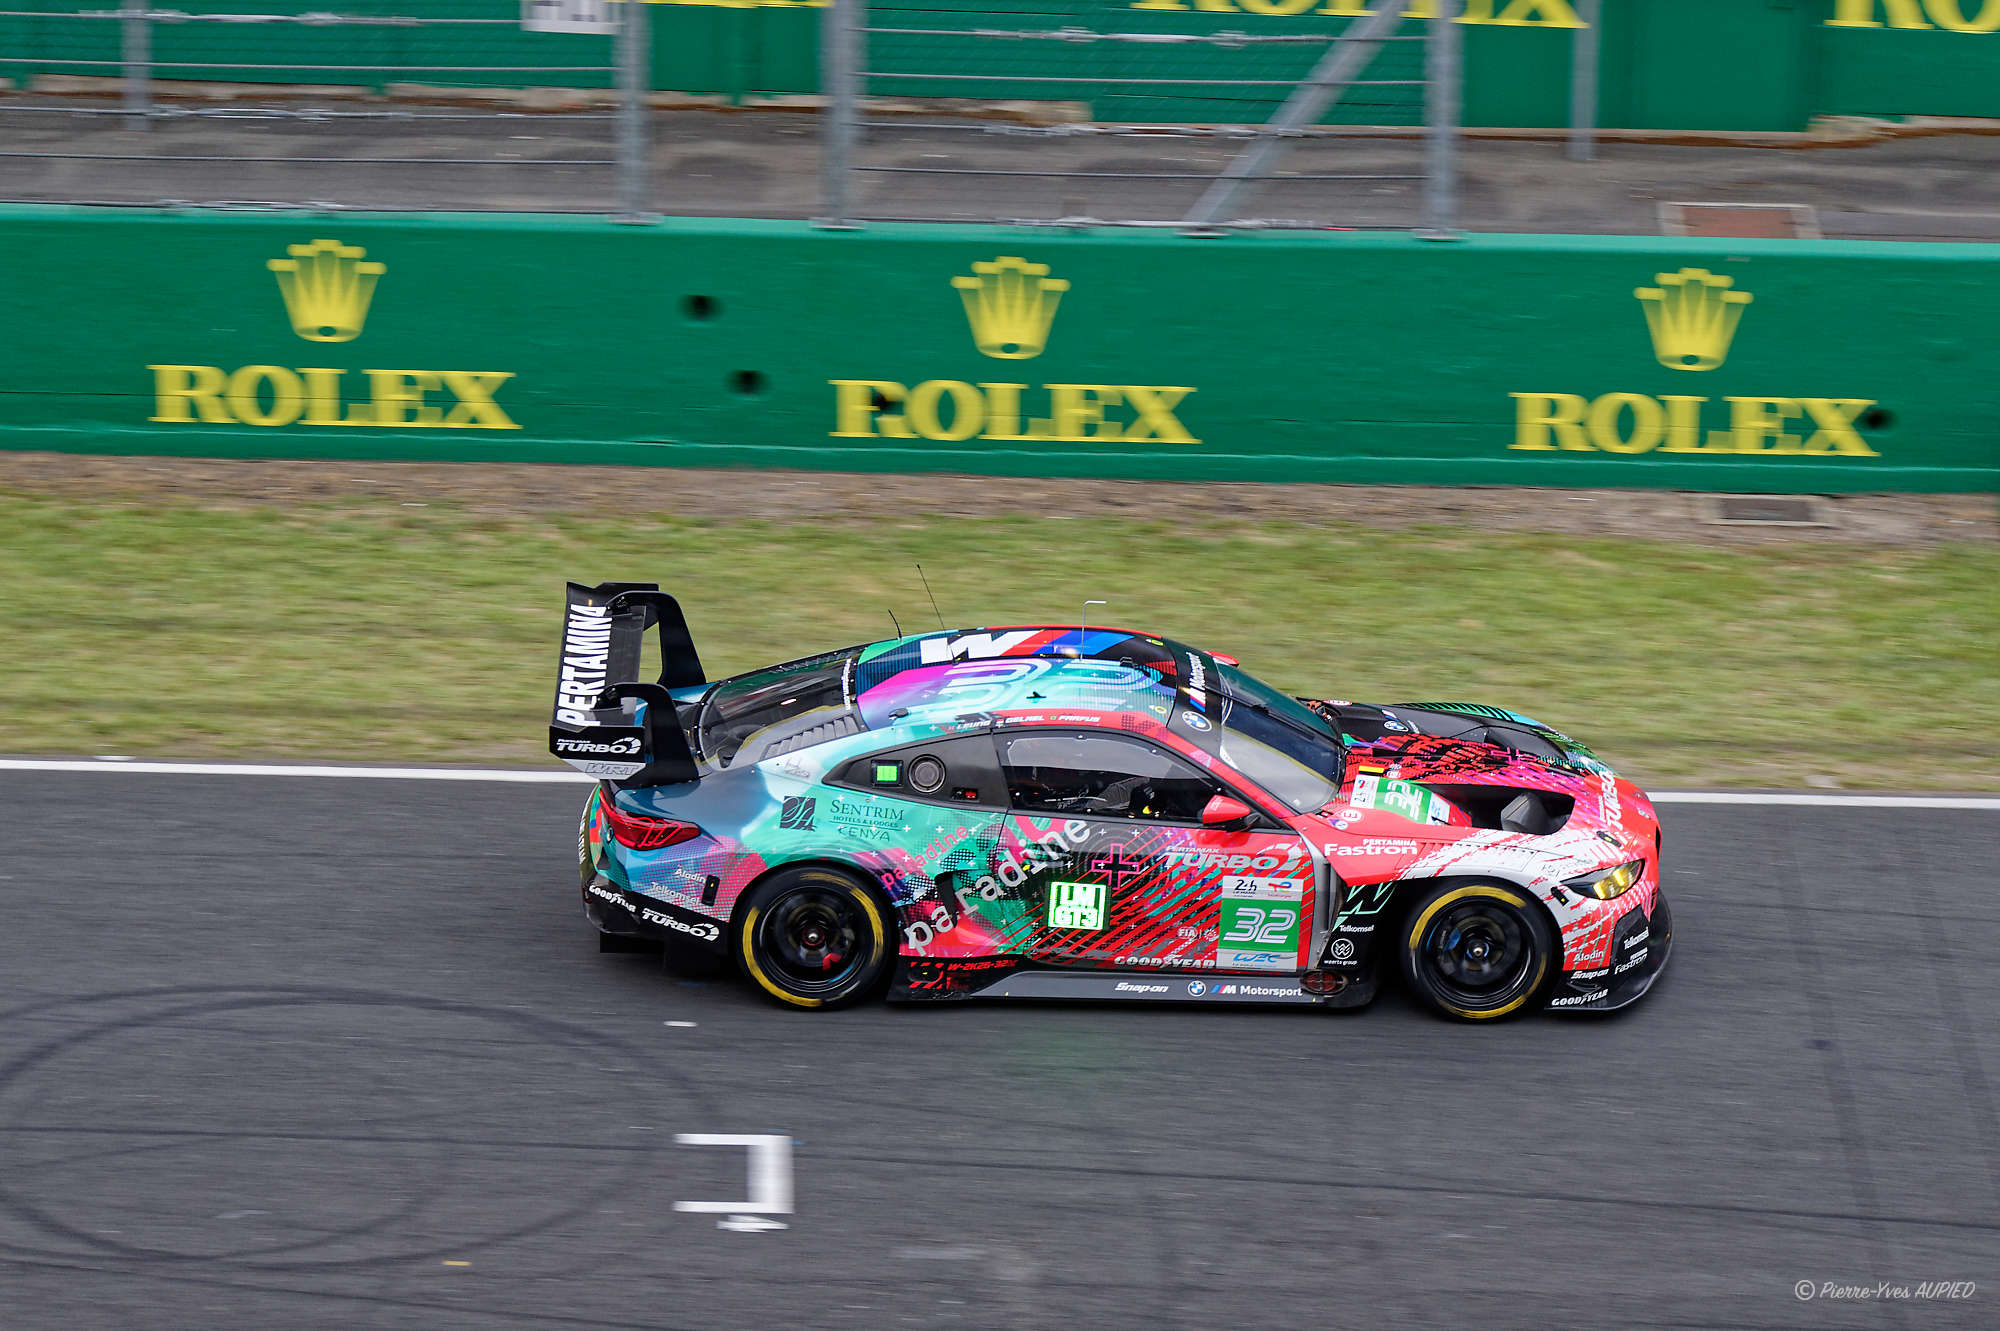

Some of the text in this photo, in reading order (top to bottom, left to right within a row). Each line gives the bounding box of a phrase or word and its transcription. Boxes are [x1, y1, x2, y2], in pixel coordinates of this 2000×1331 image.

[146, 364, 523, 429] ROLEX
[827, 380, 1202, 444] ROLEX
[1507, 392, 1881, 457] ROLEX
[556, 603, 613, 726] PERTAMINA
[556, 742, 628, 754] TURBO
[585, 762, 640, 776] WRT
[829, 799, 905, 821] SENTRIM
[1324, 843, 1418, 857] Fastron
[1363, 838, 1417, 847] PERTAMINA
[1163, 852, 1280, 870] TURBO
[904, 819, 1091, 957] paradine
[642, 910, 707, 938] TURBO
[1223, 907, 1297, 944] 32
[1114, 953, 1216, 969] GOODYEAR
[1573, 949, 1605, 962] Aladin
[1115, 982, 1169, 994] Snap-on
[1240, 984, 1303, 997] Motorsport
[1551, 988, 1609, 1007] GOODYEAR
